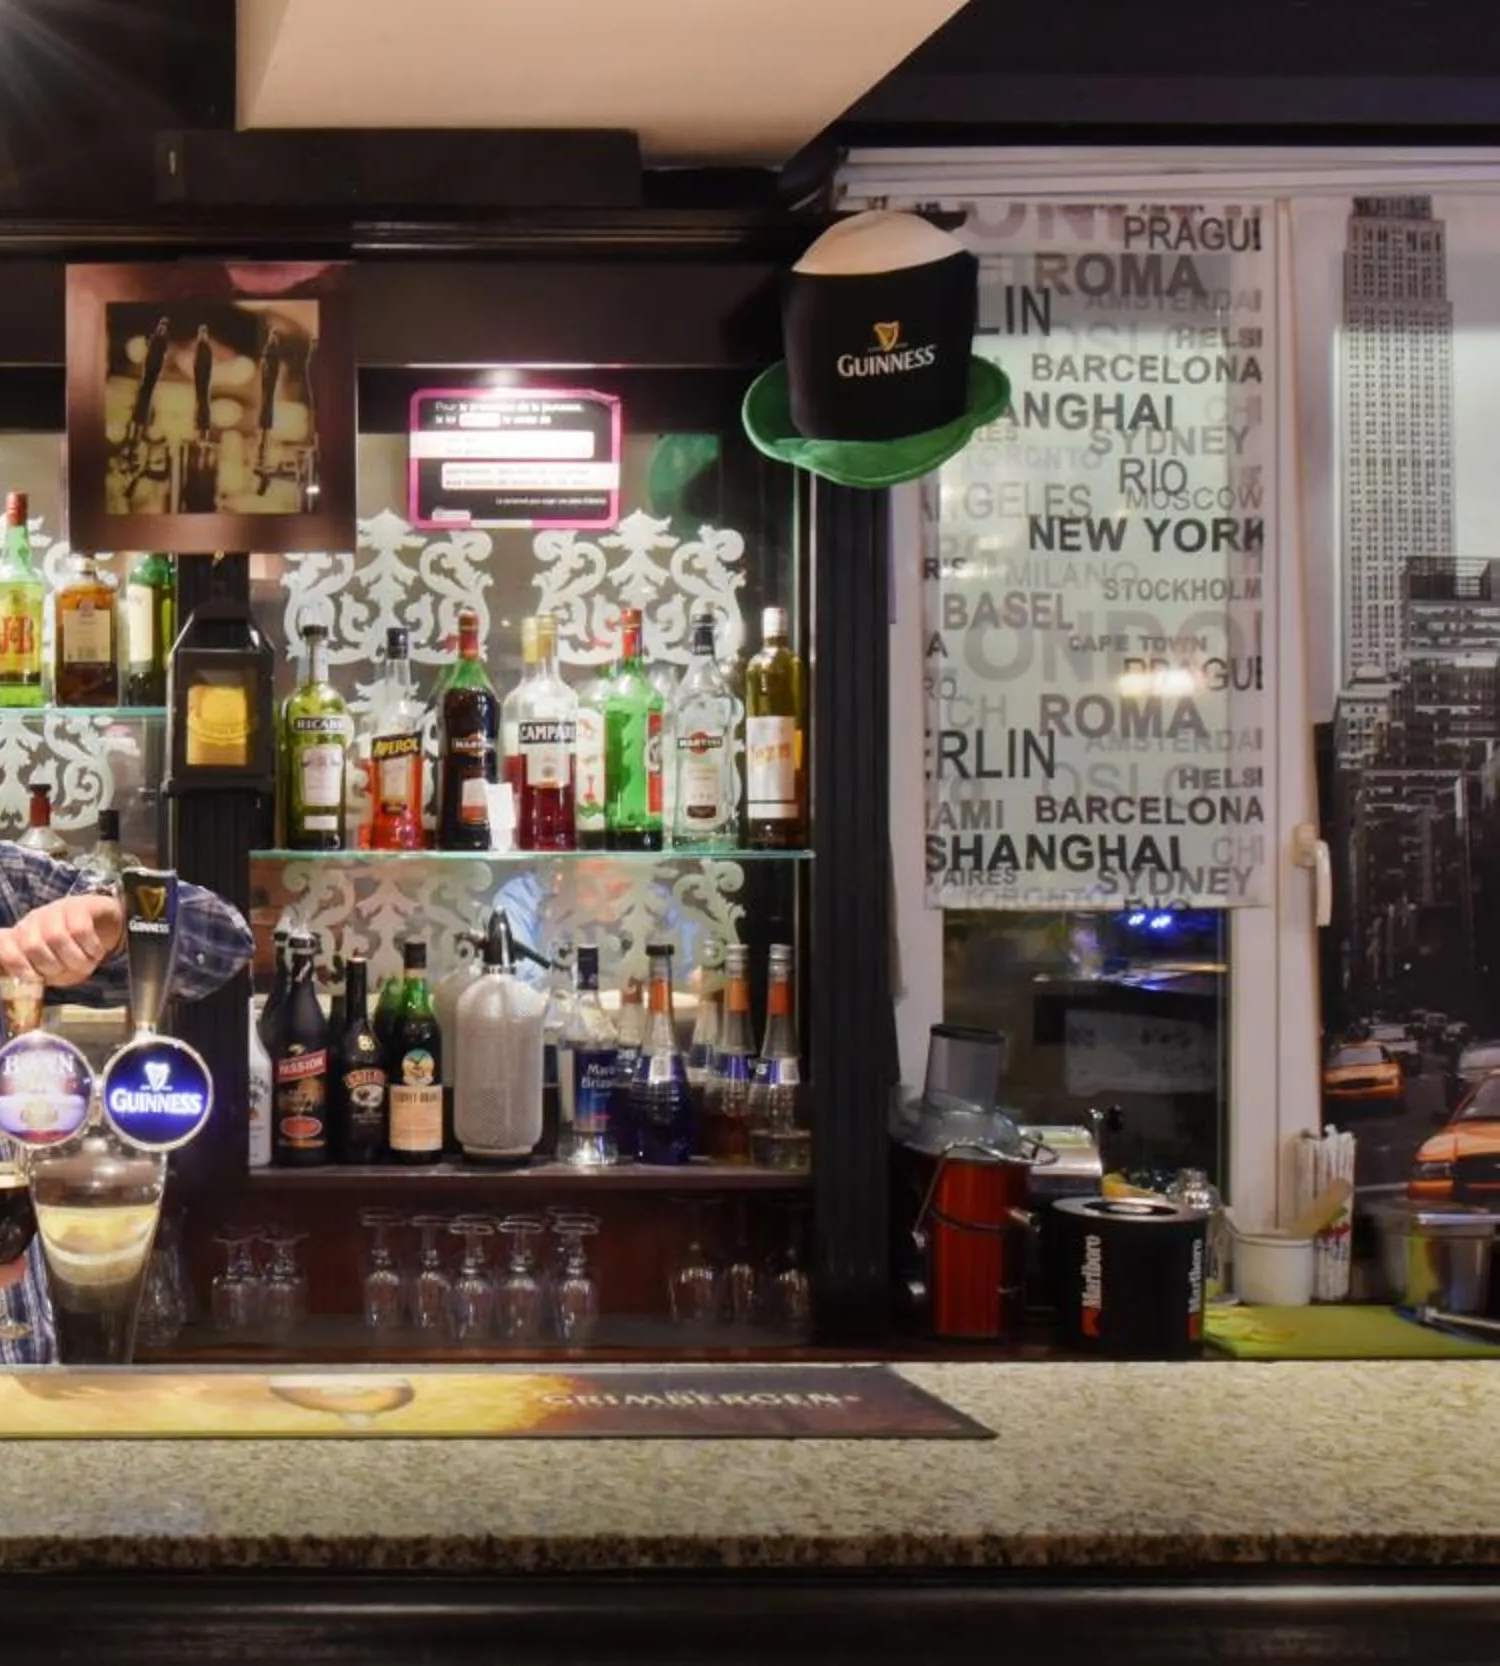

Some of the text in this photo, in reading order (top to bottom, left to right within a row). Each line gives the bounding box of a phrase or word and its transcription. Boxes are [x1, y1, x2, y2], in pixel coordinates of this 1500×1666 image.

[1033, 252, 1206, 298] ROMA
[836, 345, 937, 377] GUINNESS
[1031, 353, 1263, 384] BARCELONA
[1089, 426, 1251, 456] SYDNEY
[1118, 457, 1187, 497] RIO
[1124, 486, 1264, 511] MOSCOW
[1028, 518, 1127, 552] NEW
[1103, 578, 1262, 603] STOCKHOLM
[943, 591, 1074, 631] BASEL
[1069, 633, 1209, 653] CAPE TOWN
[296, 718, 350, 730] RICAR
[1038, 693, 1211, 740] ROMA
[924, 728, 1056, 780] RLIN
[1034, 795, 1265, 826] BARCELONA
[924, 833, 1182, 873] SHANGHAI
[941, 866, 1019, 887] AIRES
[1098, 864, 1255, 897] SYDNEY
[110, 1088, 204, 1115] GUINNESS
[1081, 1235, 1100, 1309] Marlboro
